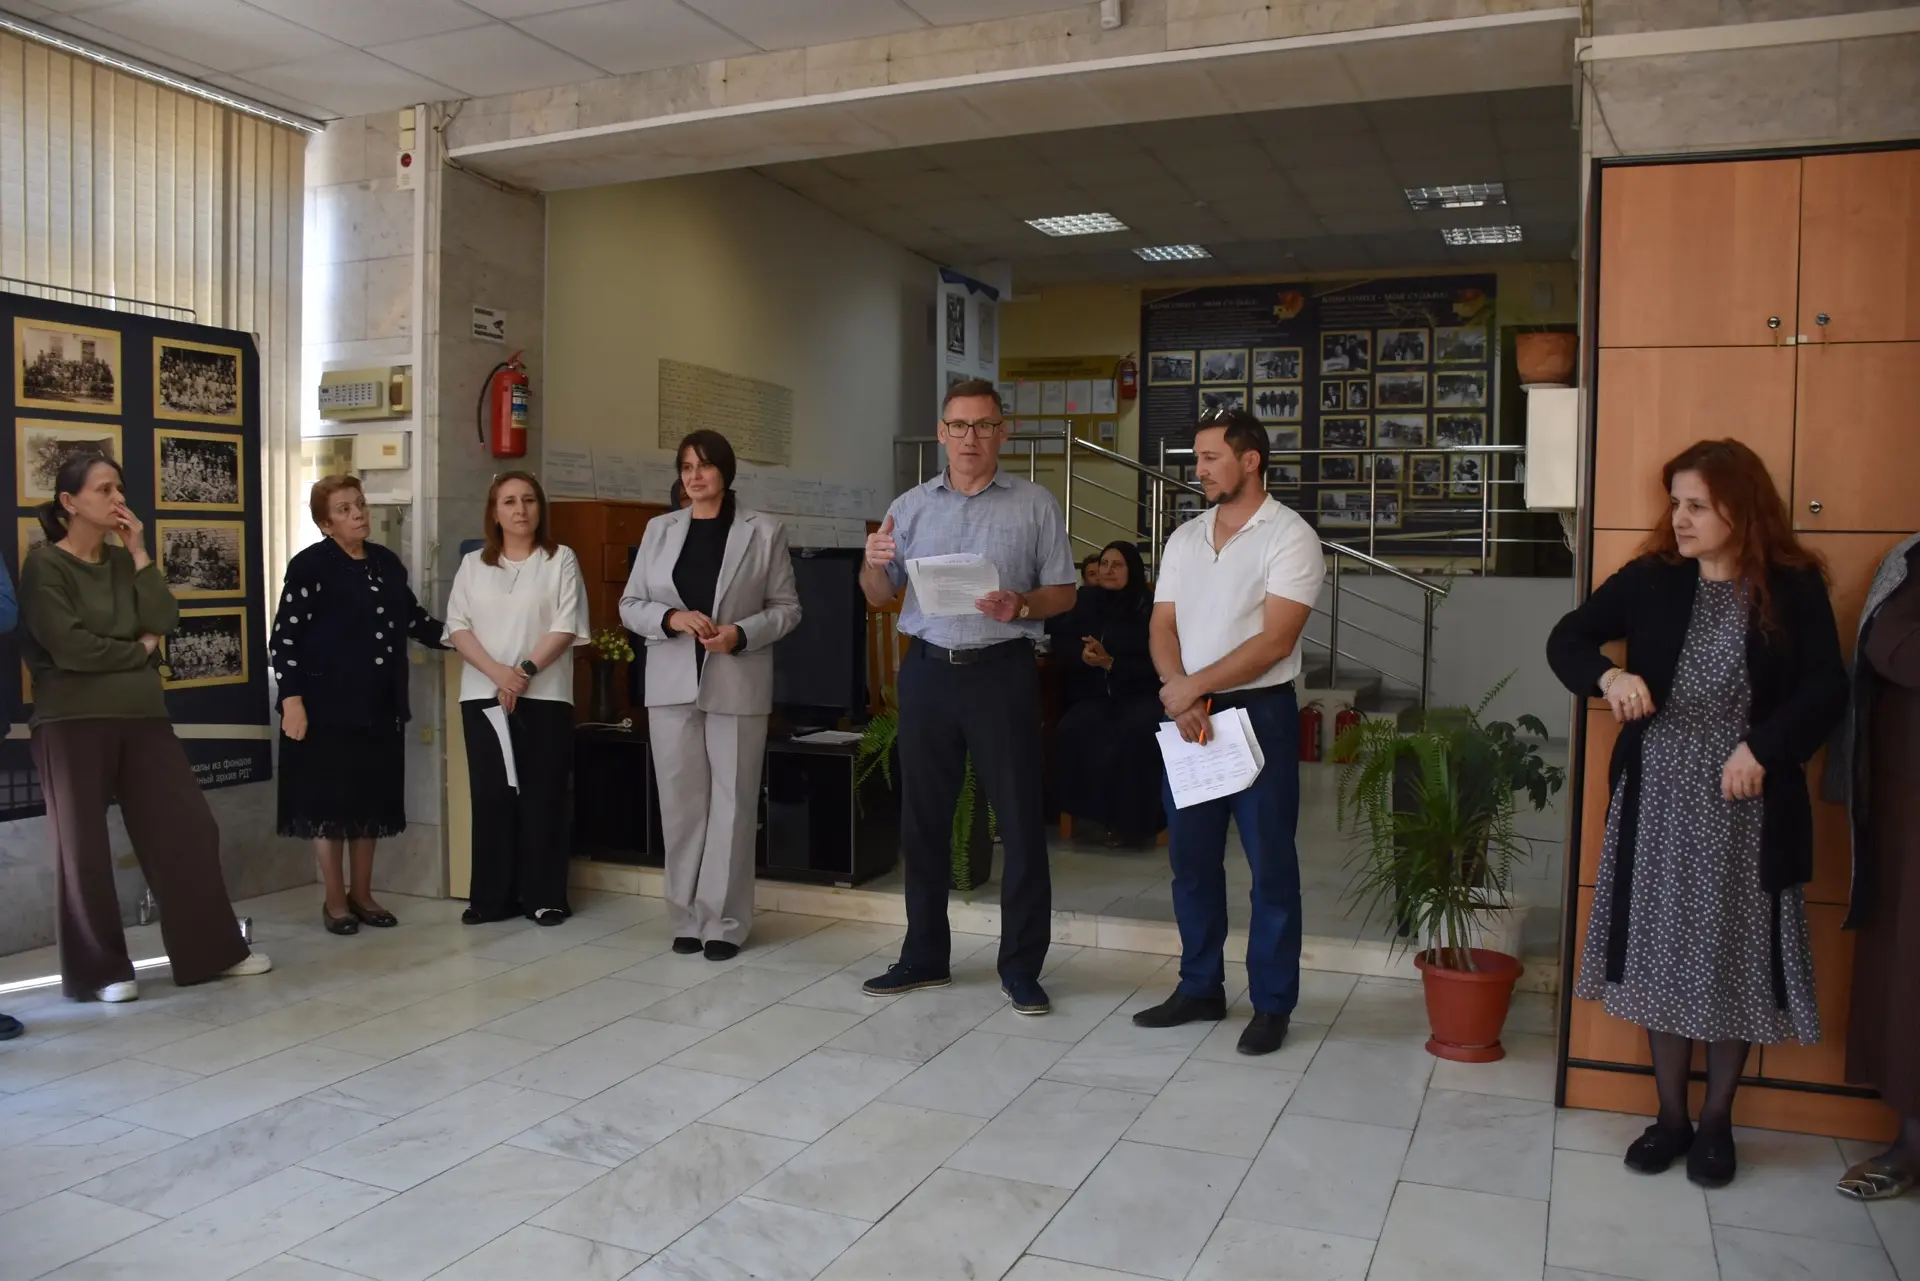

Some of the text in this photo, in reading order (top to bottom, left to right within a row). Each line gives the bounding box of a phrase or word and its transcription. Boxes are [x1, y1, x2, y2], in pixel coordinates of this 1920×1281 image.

[191, 763, 211, 773] иалы
[223, 757, 252, 769] фондов
[197, 774, 214, 785] ный
[215, 771, 237, 784] архив
